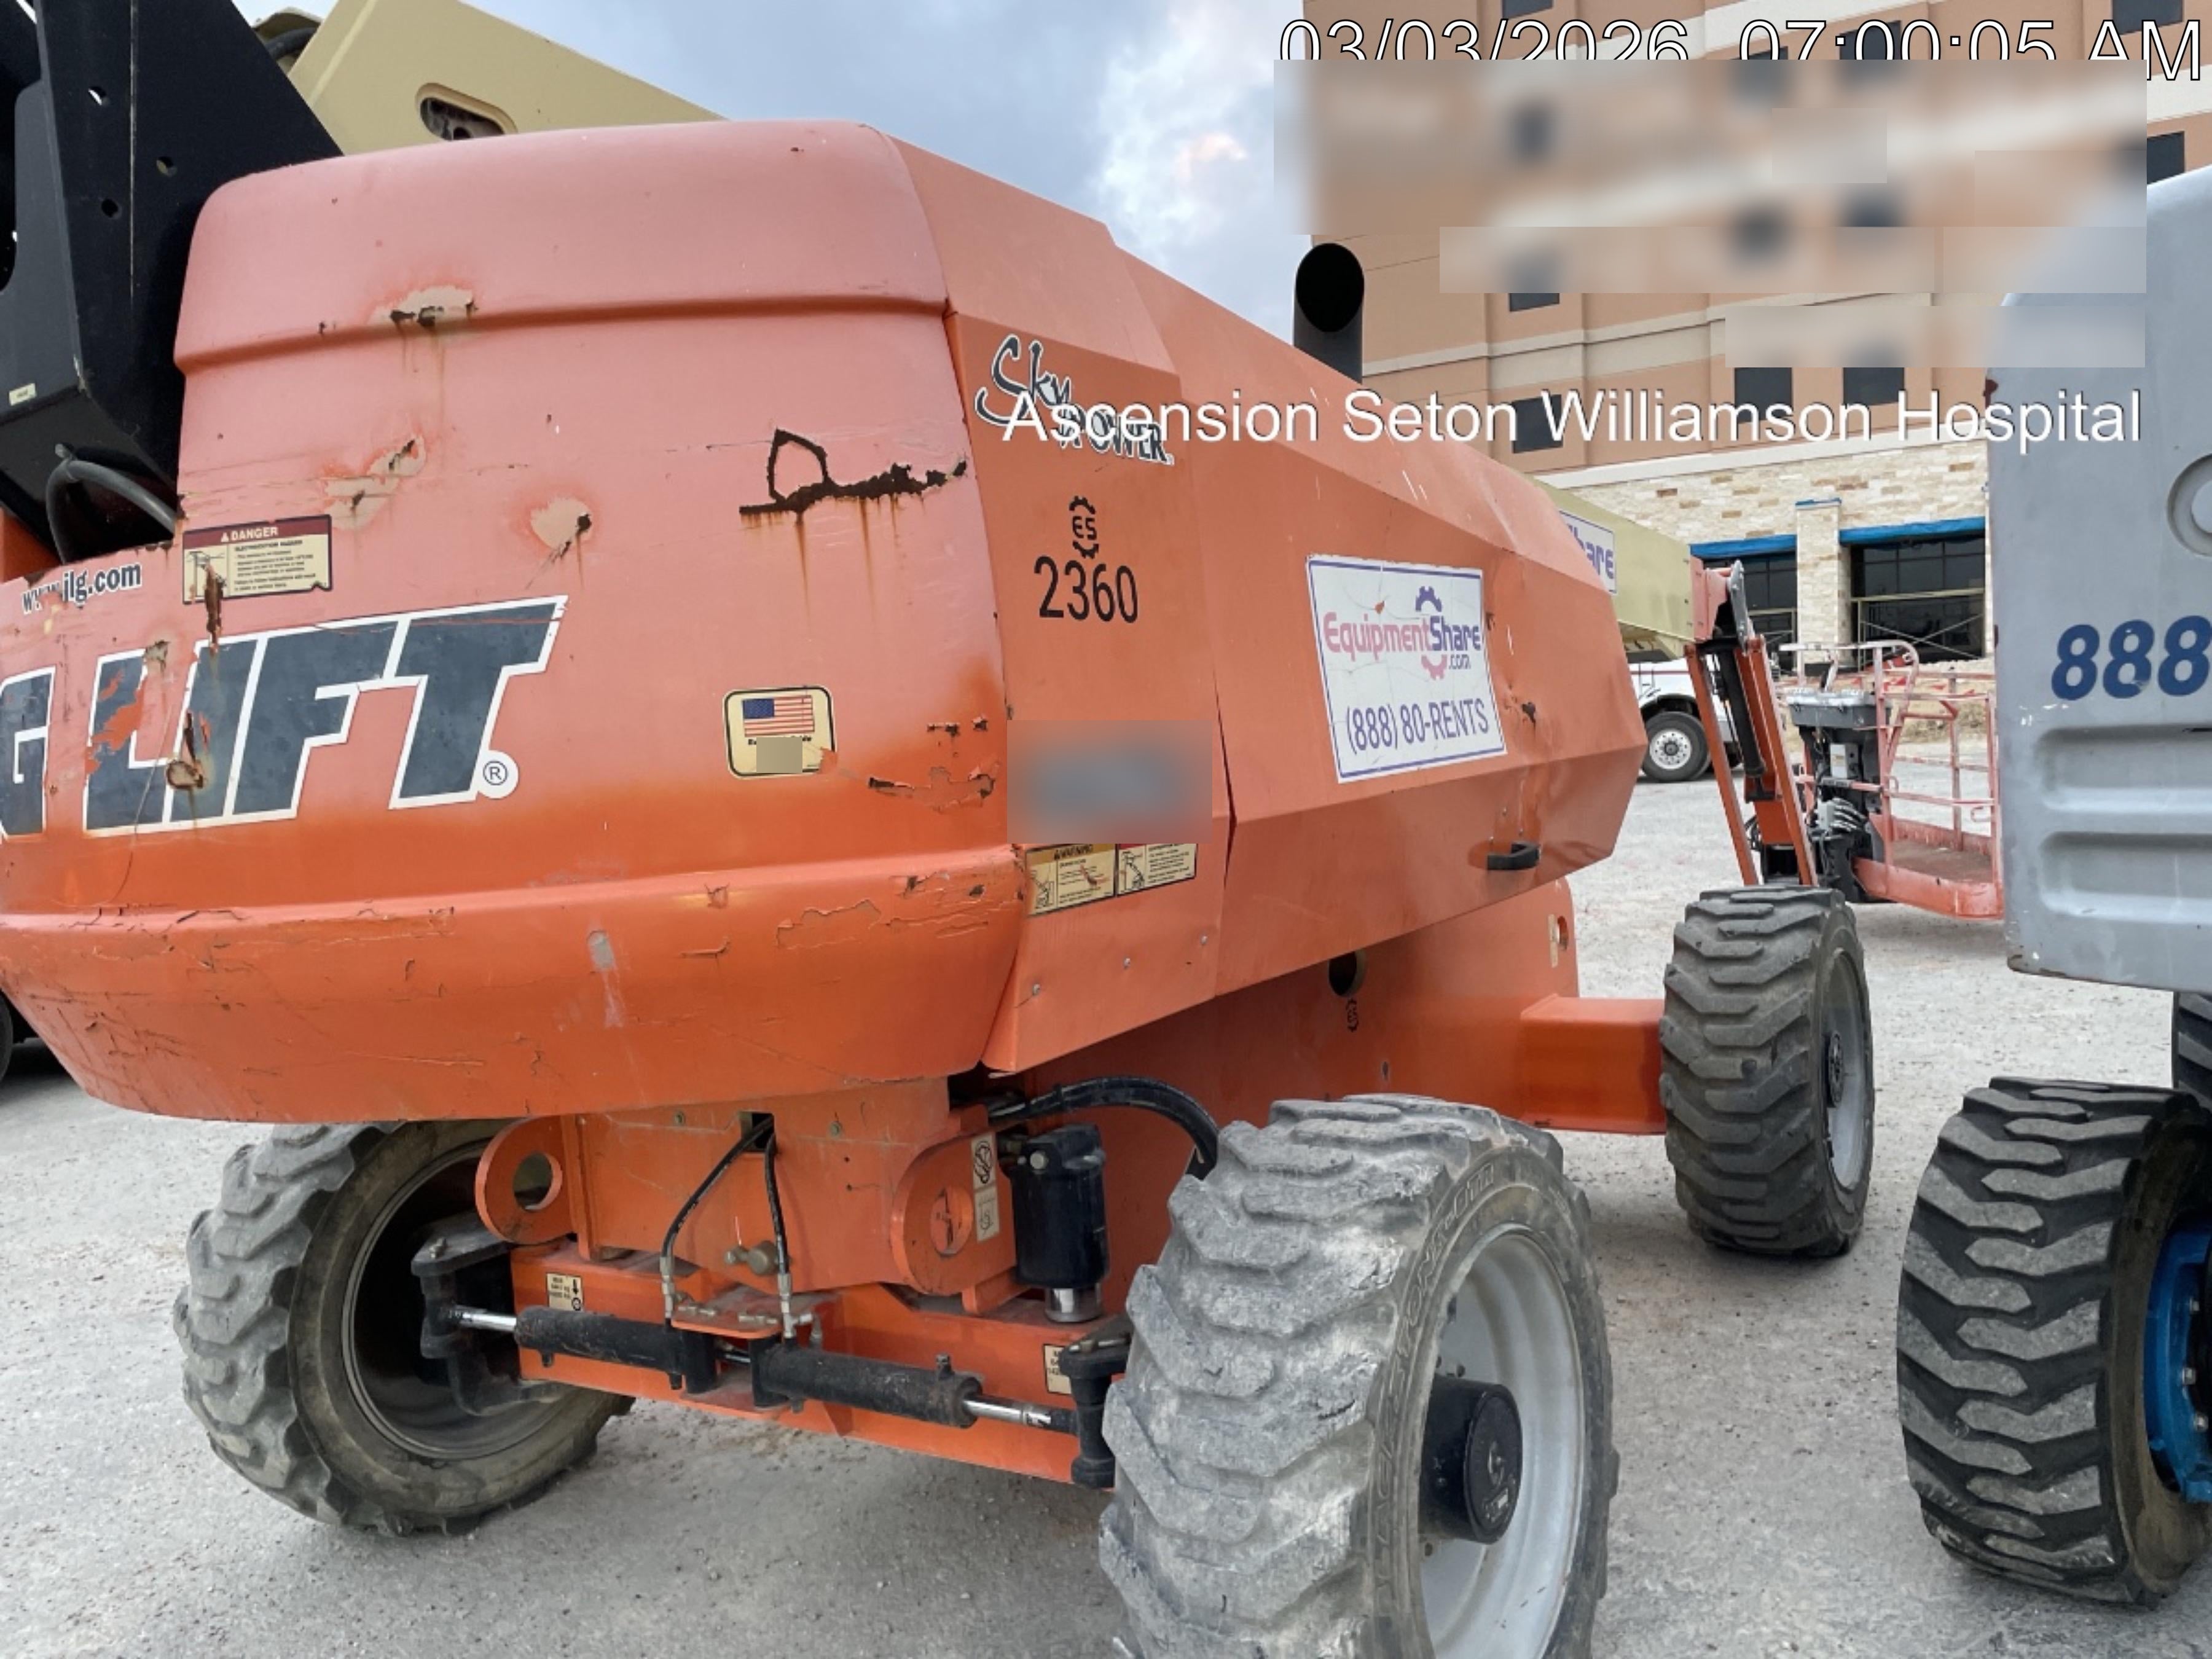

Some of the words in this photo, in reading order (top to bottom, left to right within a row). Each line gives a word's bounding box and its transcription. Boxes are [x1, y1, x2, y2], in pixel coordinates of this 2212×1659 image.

[232, 527, 278, 541] DANGER
[1034, 556, 1138, 623] 2360
[1324, 612, 1481, 662] EquipmentShare
[1449, 654, 1472, 670] .com
[2051, 615, 2212, 700] 888
[82, 596, 568, 836] LIFT
[1347, 705, 1398, 755] (888)
[1400, 698, 1489, 745] 80-RENTS
